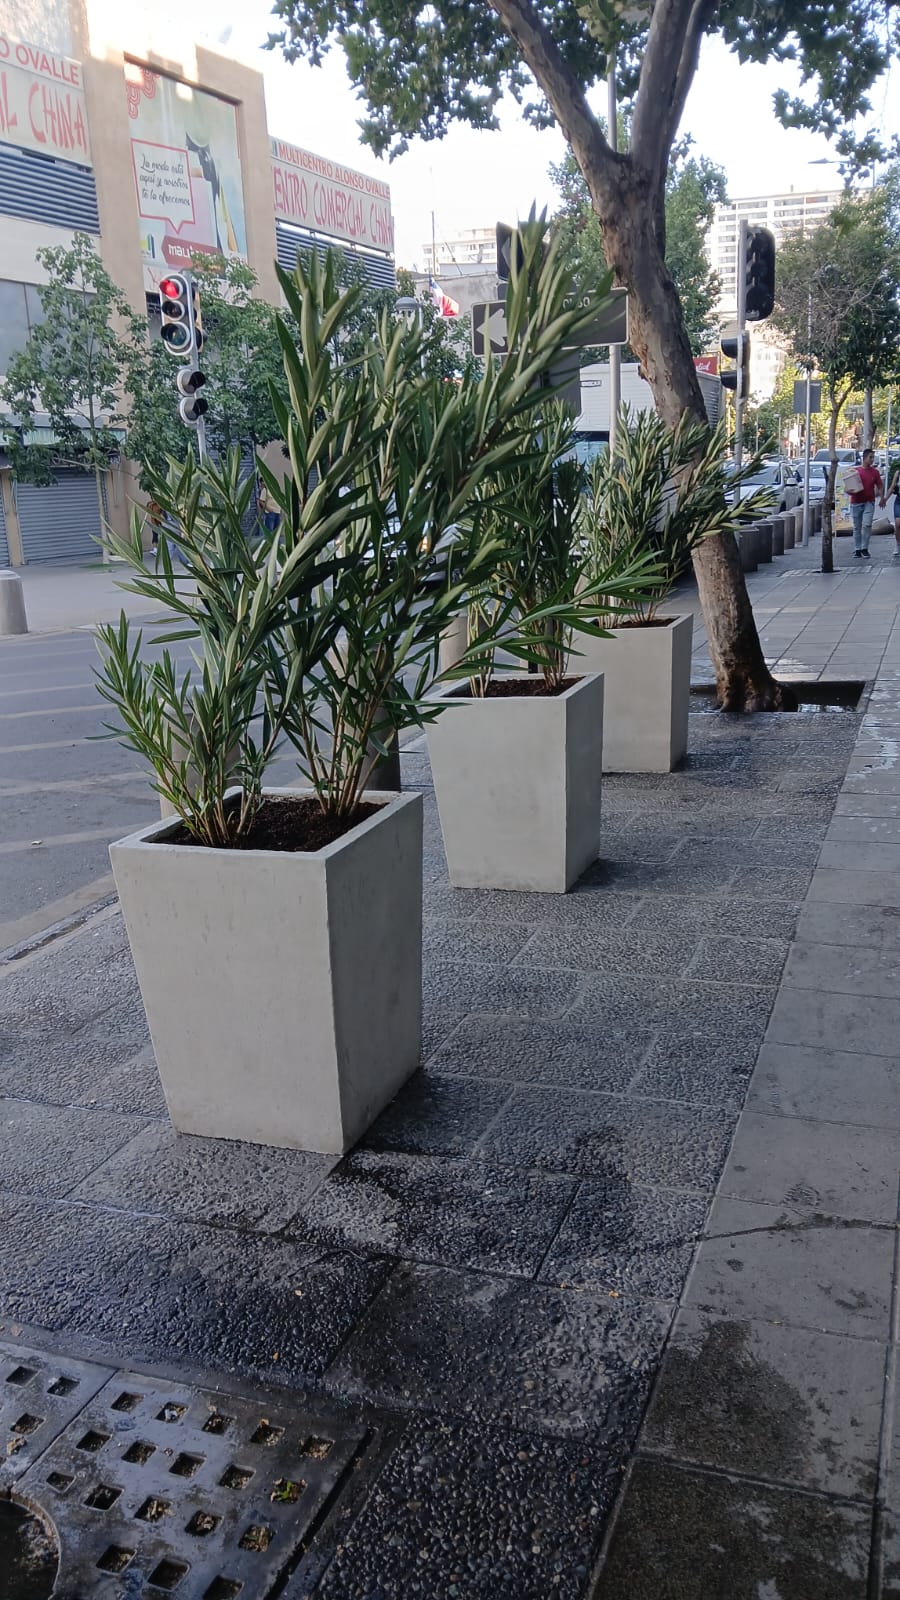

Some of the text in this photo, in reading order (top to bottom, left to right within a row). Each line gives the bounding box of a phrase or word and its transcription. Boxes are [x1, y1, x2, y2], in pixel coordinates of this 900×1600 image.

[15, 44, 80, 86] OVALLE
[28, 80, 88, 156] CHINA
[141, 153, 155, 173] La
[152, 161, 169, 172] moda
[157, 177, 163, 188] y
[164, 178, 188, 190] nosotros
[278, 142, 391, 200] MULTICENTRO ALONSO OVALLE
[142, 187, 190, 207] te la ofrecemos
[271, 165, 308, 220] ENTRO
[313, 181, 367, 237] COMERCIAL
